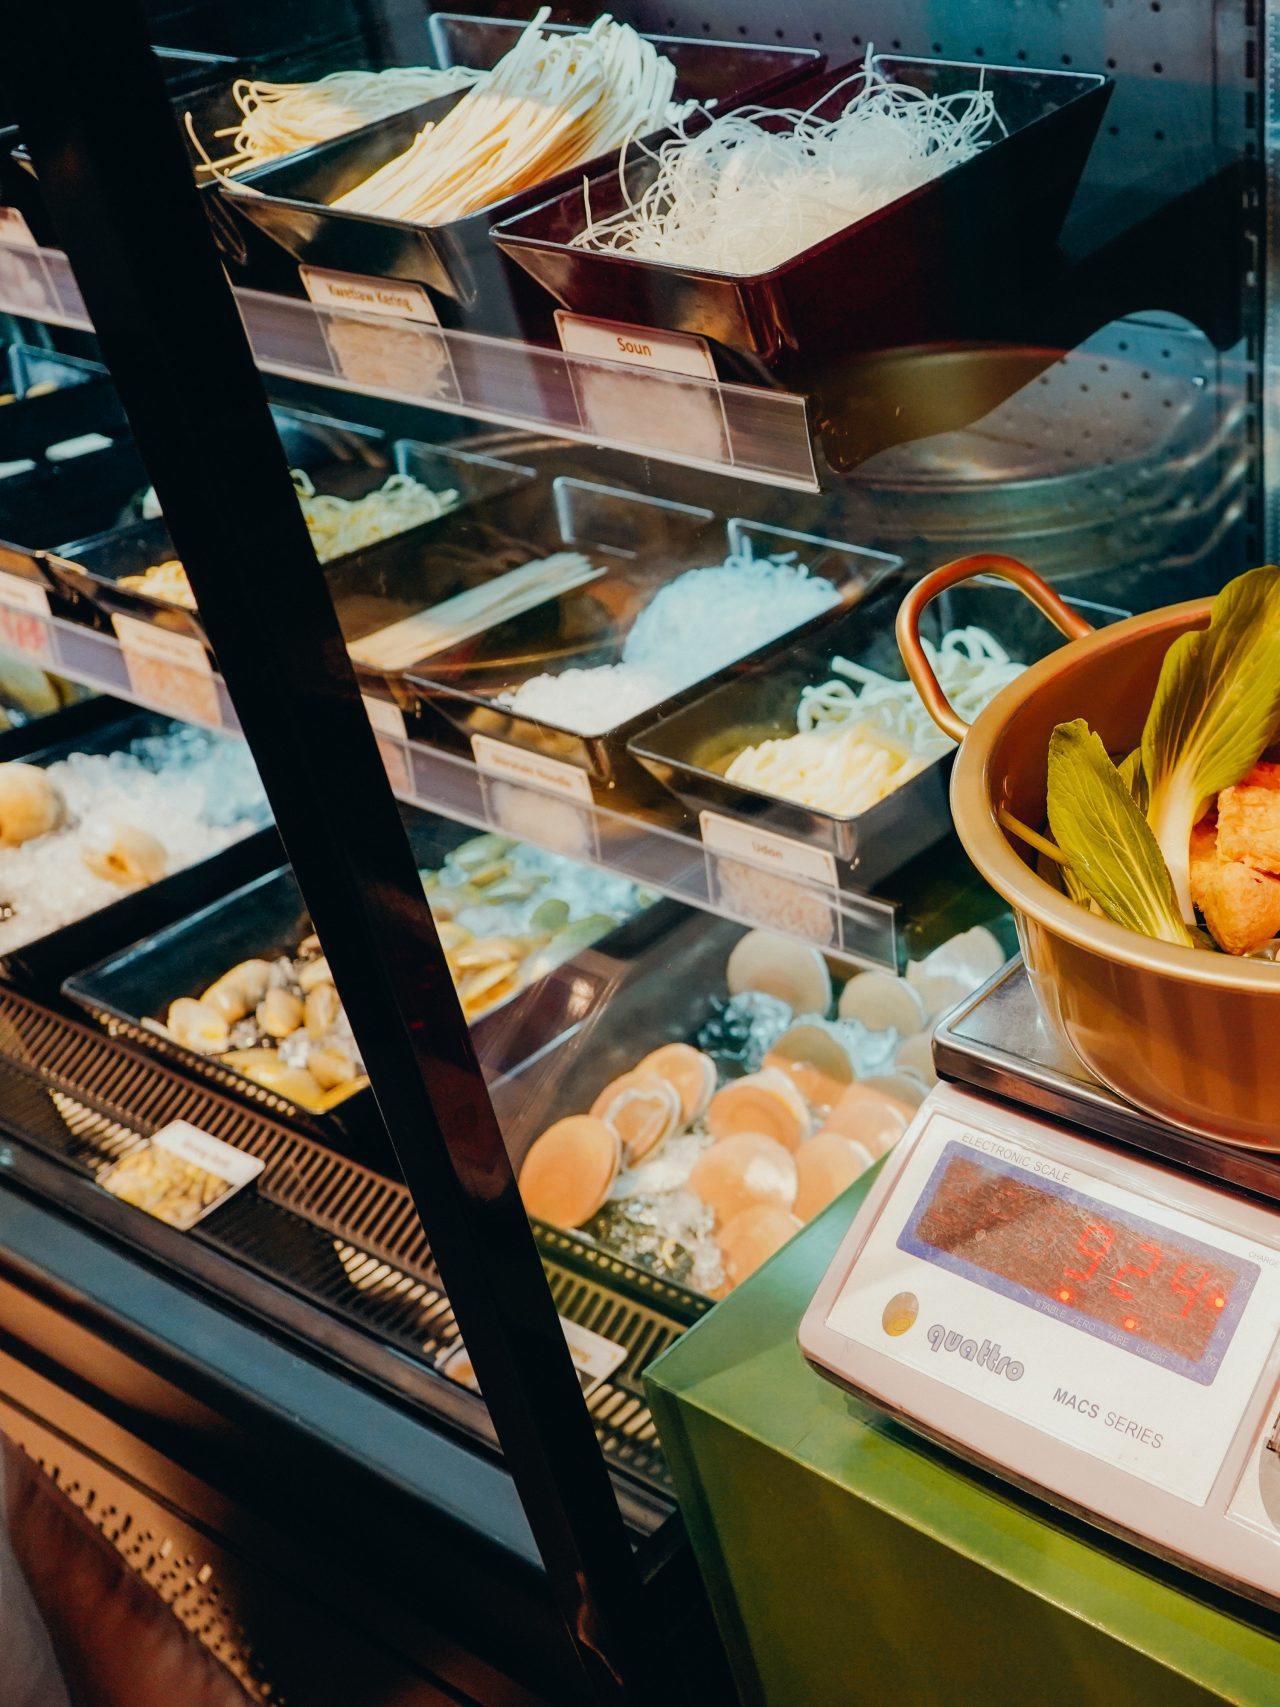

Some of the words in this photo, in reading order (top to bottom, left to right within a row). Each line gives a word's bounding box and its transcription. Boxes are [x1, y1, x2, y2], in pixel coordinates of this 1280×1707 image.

[616, 336, 652, 357] Soun
[961, 1131, 1031, 1168] ELECTRONIC
[1033, 1160, 1072, 1184] SCALE
[1063, 1223, 1216, 1319] 924
[1034, 1299, 1067, 1319] STABLE
[1070, 1315, 1096, 1332] ZERO
[1107, 1331, 1129, 1348] TARE
[926, 1323, 1026, 1382] quattro
[1052, 1387, 1101, 1419] MACS
[1103, 1411, 1165, 1449] SERIES
